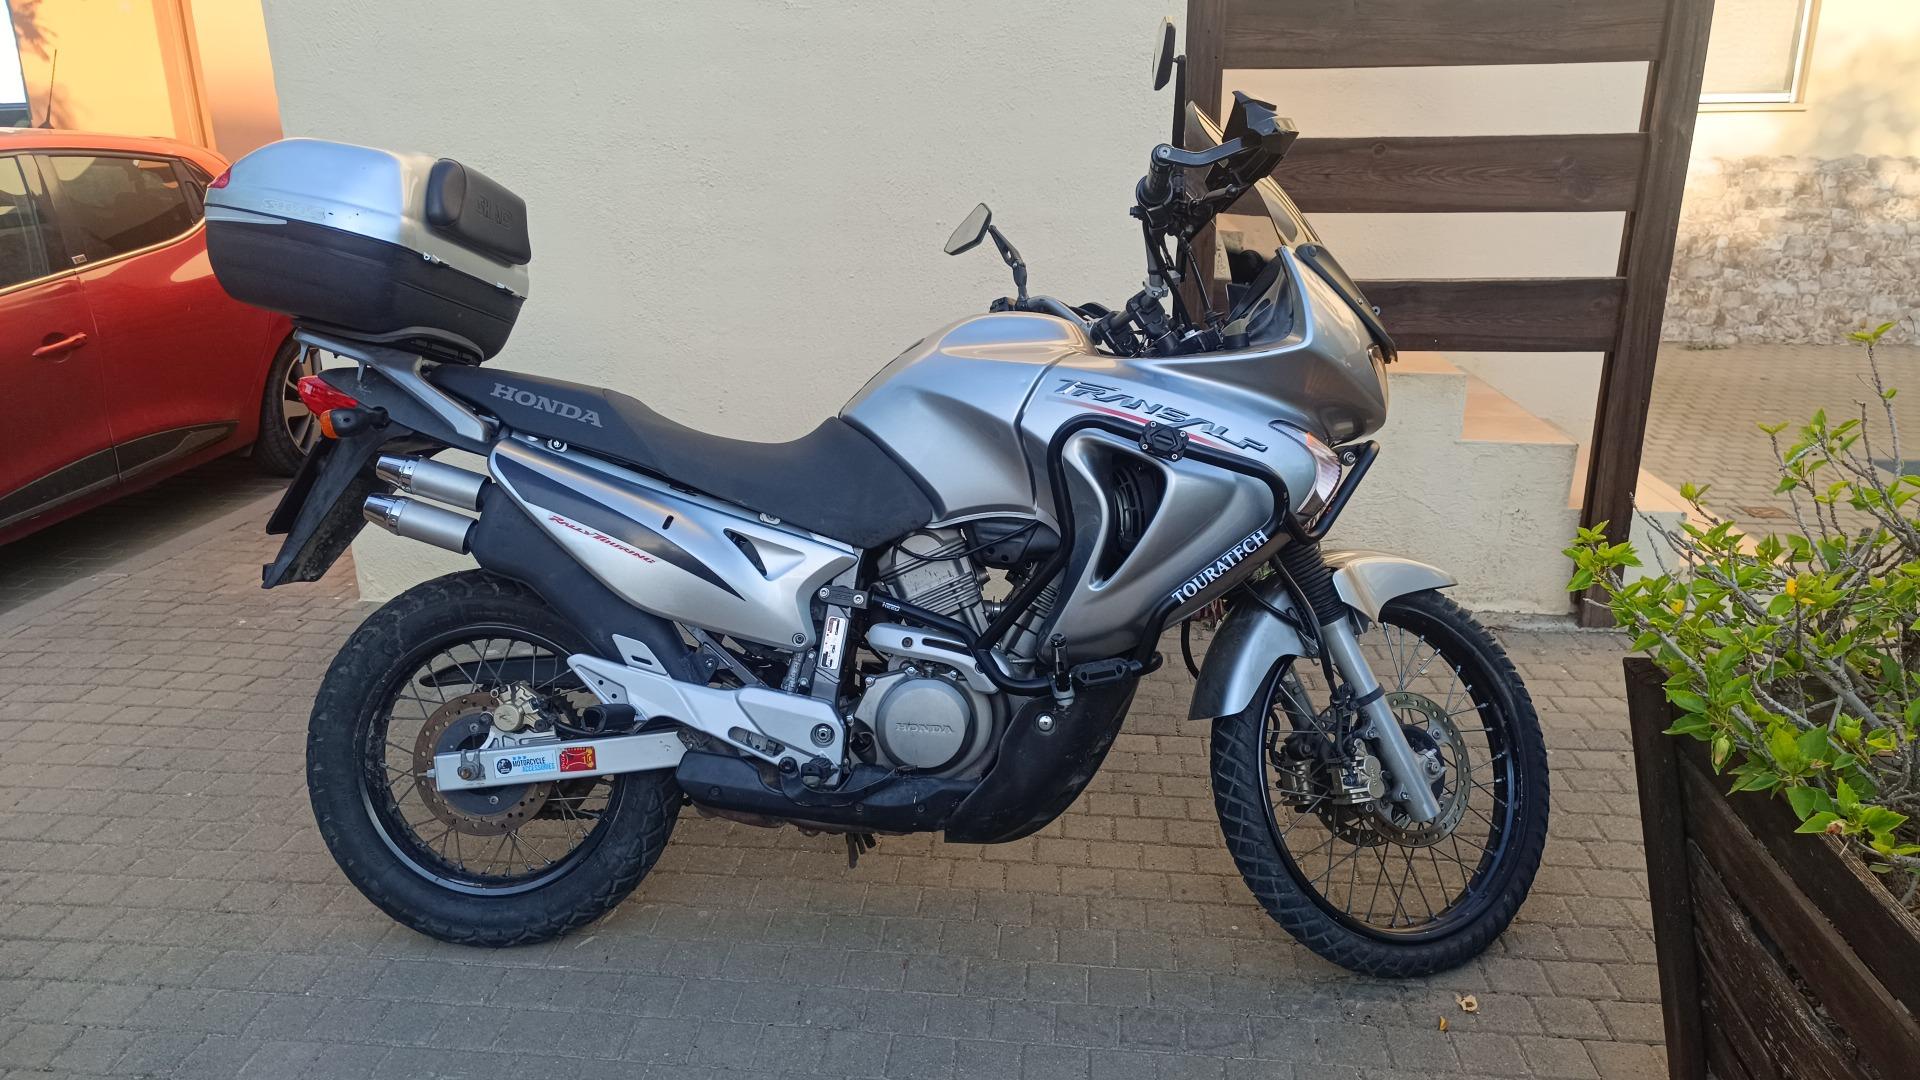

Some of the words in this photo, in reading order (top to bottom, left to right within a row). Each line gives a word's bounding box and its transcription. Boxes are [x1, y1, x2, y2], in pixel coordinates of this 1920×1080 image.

[490, 382, 603, 428] HONDA
[1054, 379, 1269, 452] TRANSALP
[1171, 529, 1270, 605] TOURATECH
[895, 722, 954, 735] HONDA
